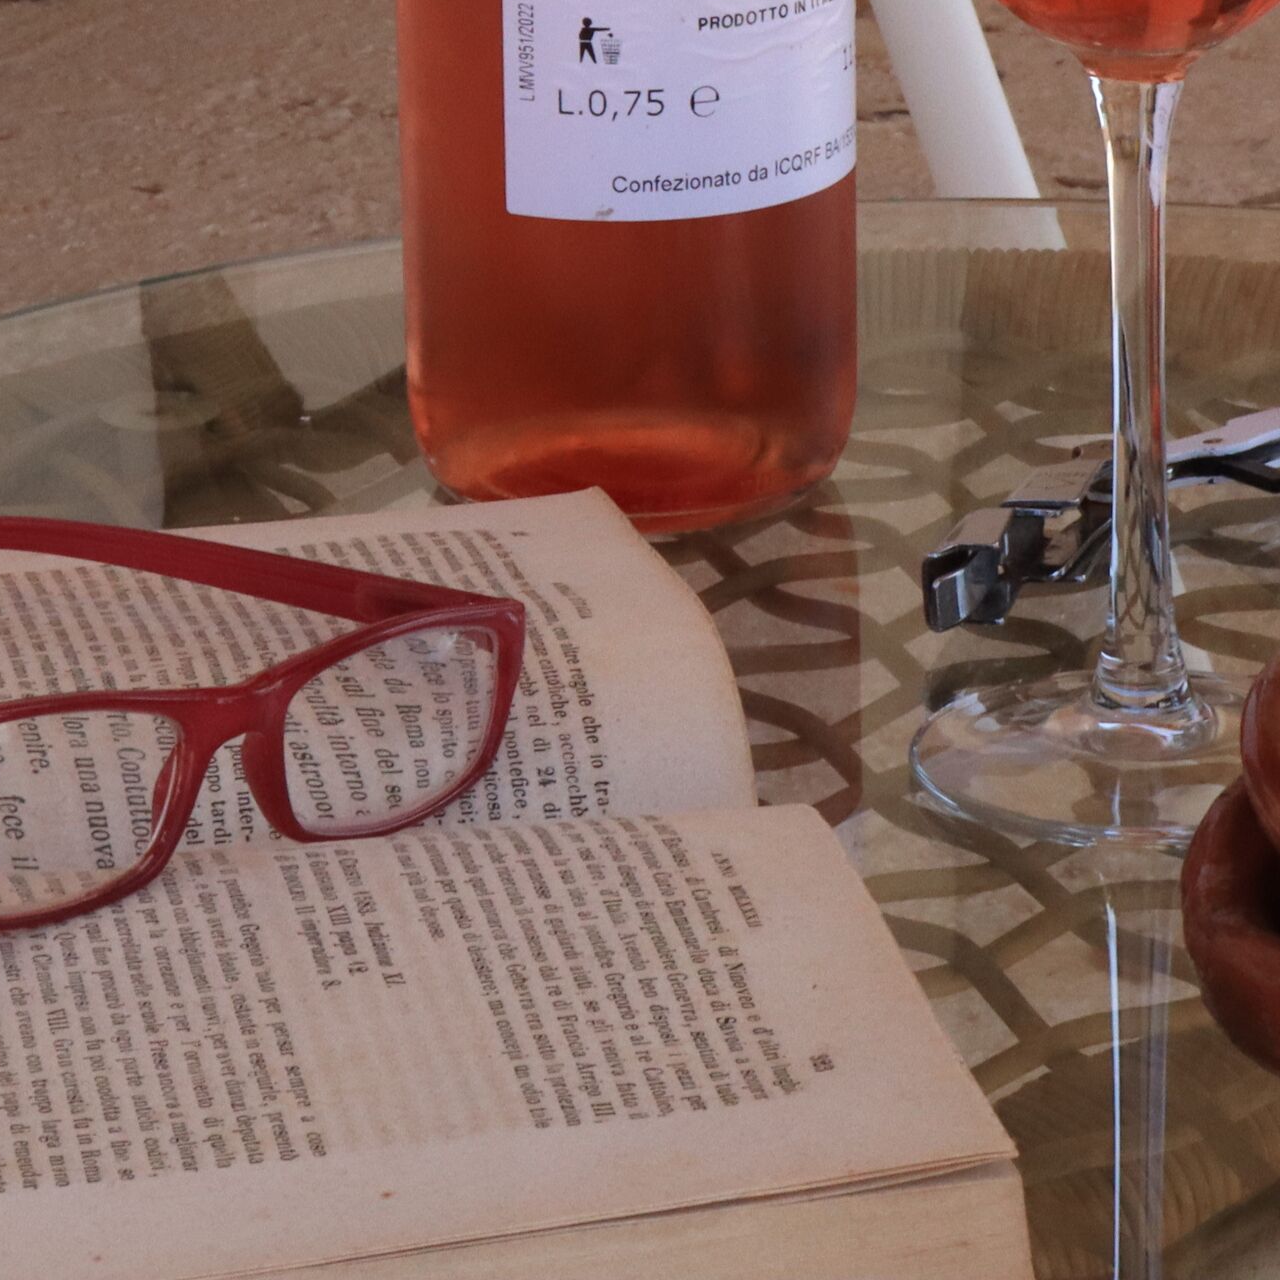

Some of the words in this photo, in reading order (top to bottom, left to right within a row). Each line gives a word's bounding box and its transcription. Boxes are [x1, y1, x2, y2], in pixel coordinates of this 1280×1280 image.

[697, 3, 789, 31] PRODOTTO
[793, 0, 807, 15] IN
[557, 88, 666, 122] L.0,75
[611, 169, 742, 194] Confezionato
[747, 164, 769, 183] da
[774, 146, 822, 177] ICQRF
[334, 675, 376, 698] sul
[417, 660, 447, 687] fece
[450, 658, 479, 696] presso
[568, 667, 595, 708] regole
[354, 706, 386, 738] fine
[431, 708, 459, 759] spirito
[526, 705, 545, 728] nel
[581, 715, 601, 744] che
[373, 748, 403, 775] del
[394, 703, 425, 749] Roma
[413, 758, 431, 789] non
[73, 757, 100, 794] una
[326, 734, 369, 802] intorno
[558, 733, 590, 818] acciocchè
[236, 791, 254, 843] inter-
[593, 780, 611, 815] tra-
[84, 801, 116, 871] nuova
[210, 800, 232, 846] tardi
[239, 923, 269, 967] Gregorio
[604, 972, 639, 1021] Gregorio
[696, 967, 720, 997] duca
[715, 1015, 744, 1053] Savoia
[148, 1039, 170, 1071] Prese
[532, 1033, 557, 1061] sotto
[556, 1014, 590, 1059] Francia
[284, 1064, 312, 1108] sempre
[306, 1131, 327, 1157] cose
[201, 1133, 233, 1169] quella
[232, 1114, 265, 1165] deputata
[261, 1111, 300, 1162] presentò
[80, 1149, 102, 1184] Roma
